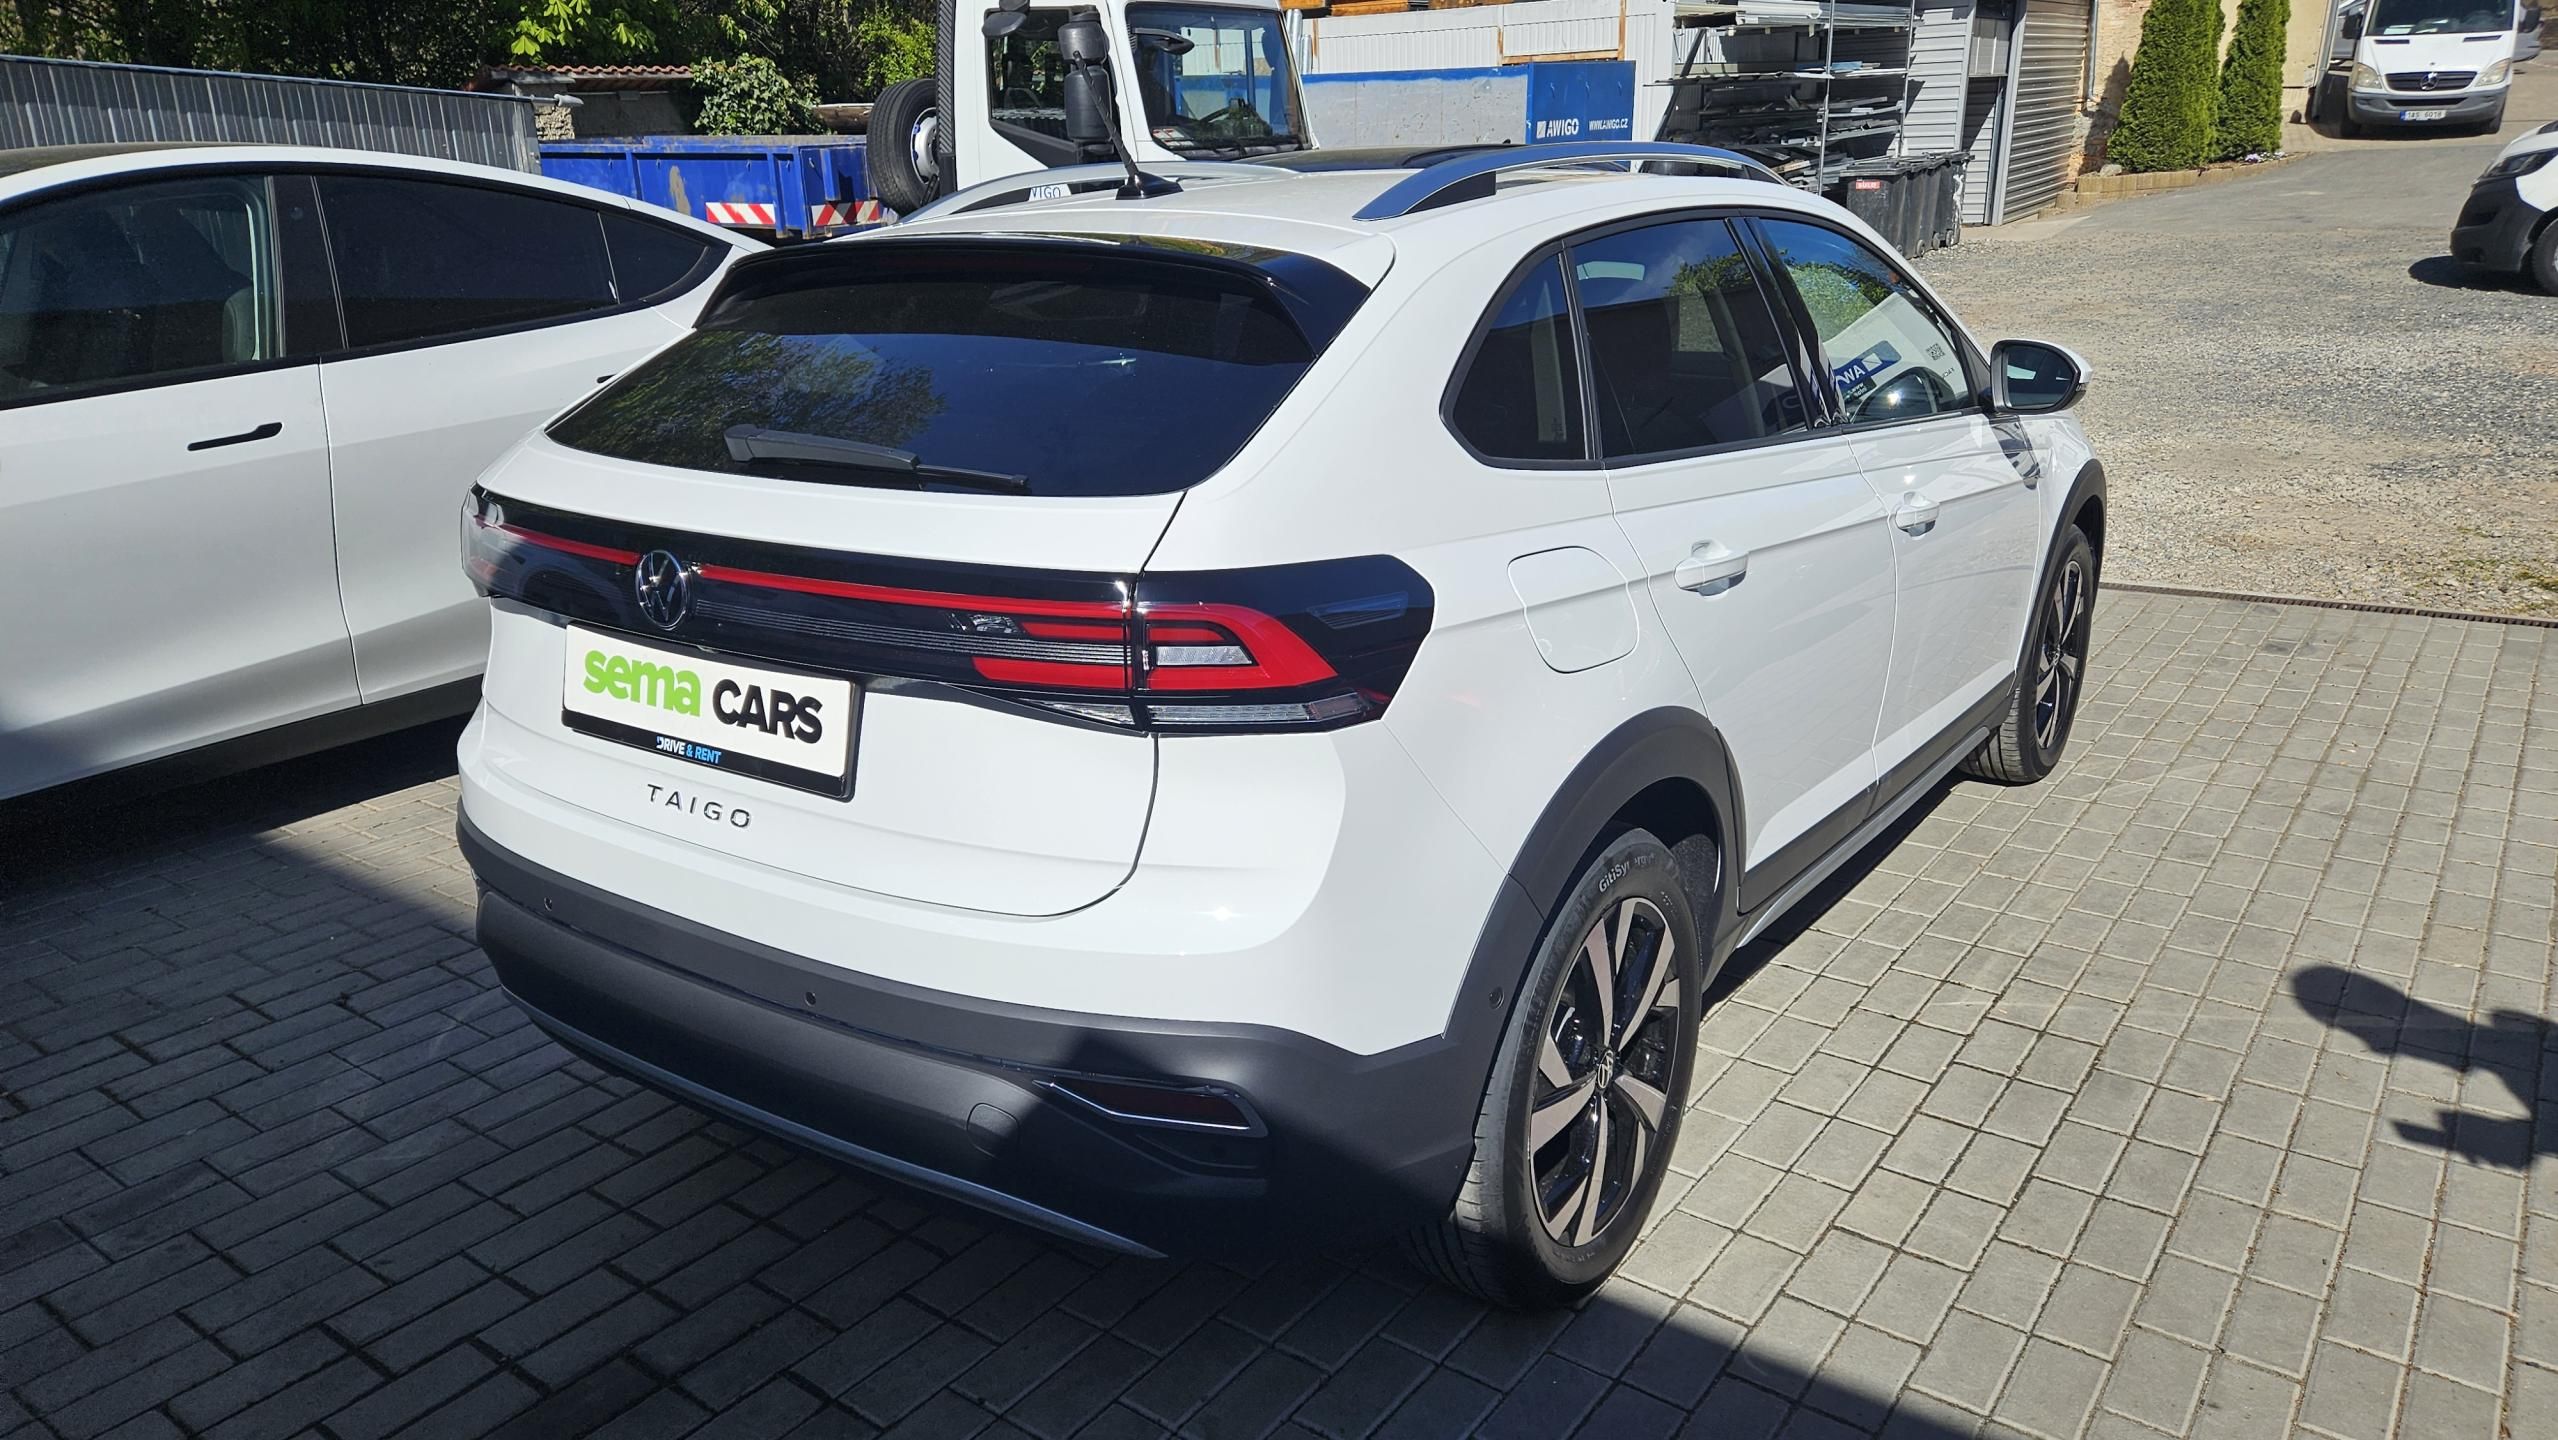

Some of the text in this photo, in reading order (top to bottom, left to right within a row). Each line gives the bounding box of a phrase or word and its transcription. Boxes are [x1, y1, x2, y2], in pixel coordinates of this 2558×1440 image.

[1547, 118, 1579, 137] AWIGO
[583, 650, 823, 745] sema CARS
[656, 735, 722, 765] DRIVE & RENT
[647, 783, 752, 828] TAIGO
